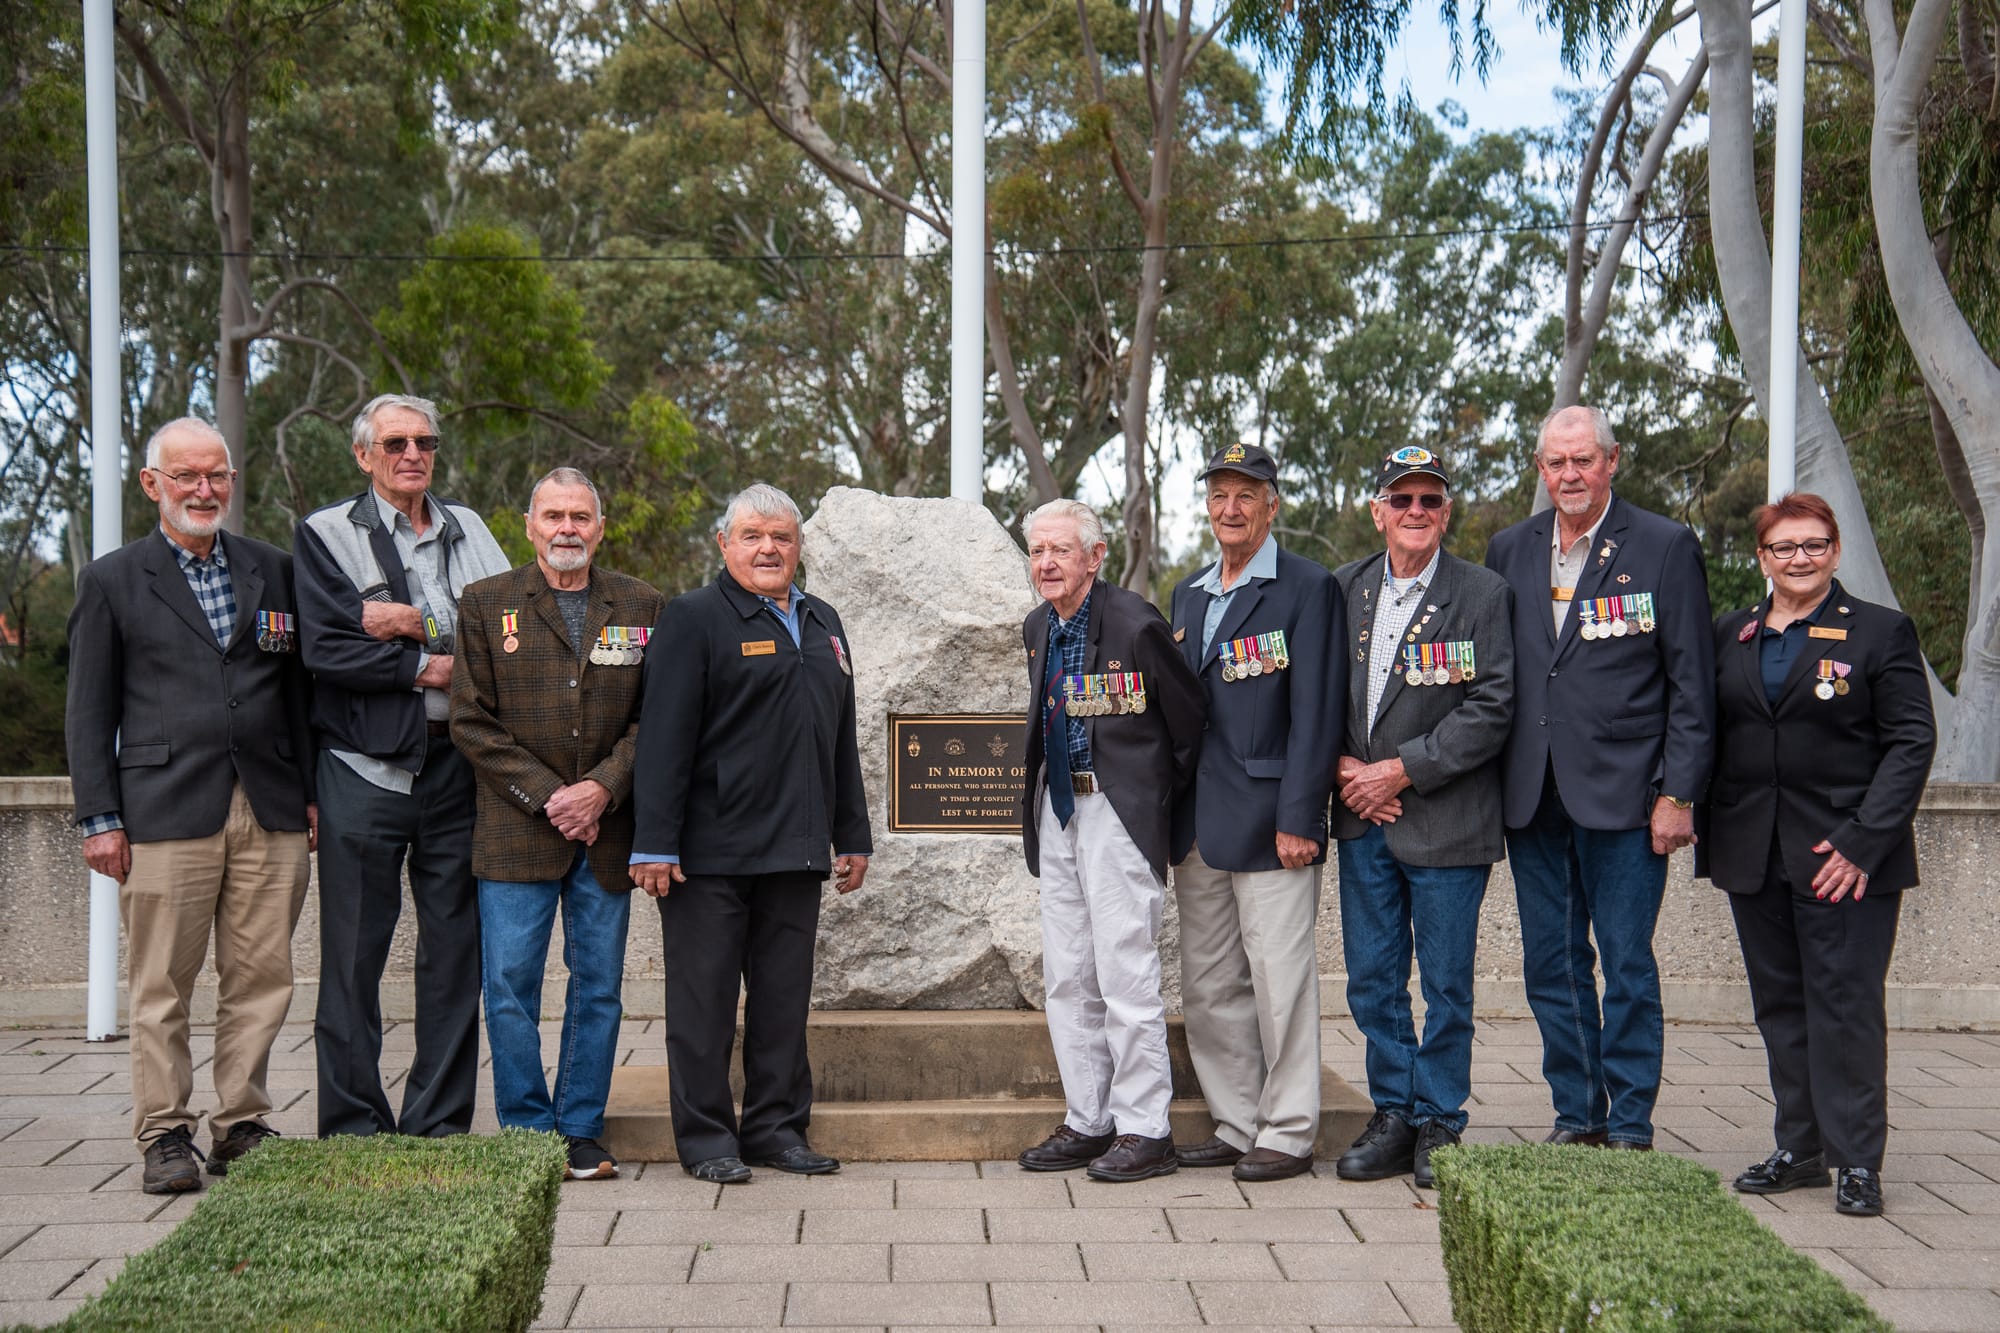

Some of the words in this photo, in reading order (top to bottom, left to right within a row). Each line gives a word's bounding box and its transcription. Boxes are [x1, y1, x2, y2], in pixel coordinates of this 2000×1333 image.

[928, 767, 942, 776] IN
[948, 767, 1004, 776] MEMORY
[1010, 767, 1027, 776] OF
[942, 809, 961, 817] LEST
[965, 809, 978, 817] WE
[981, 809, 1014, 817] FORGET
